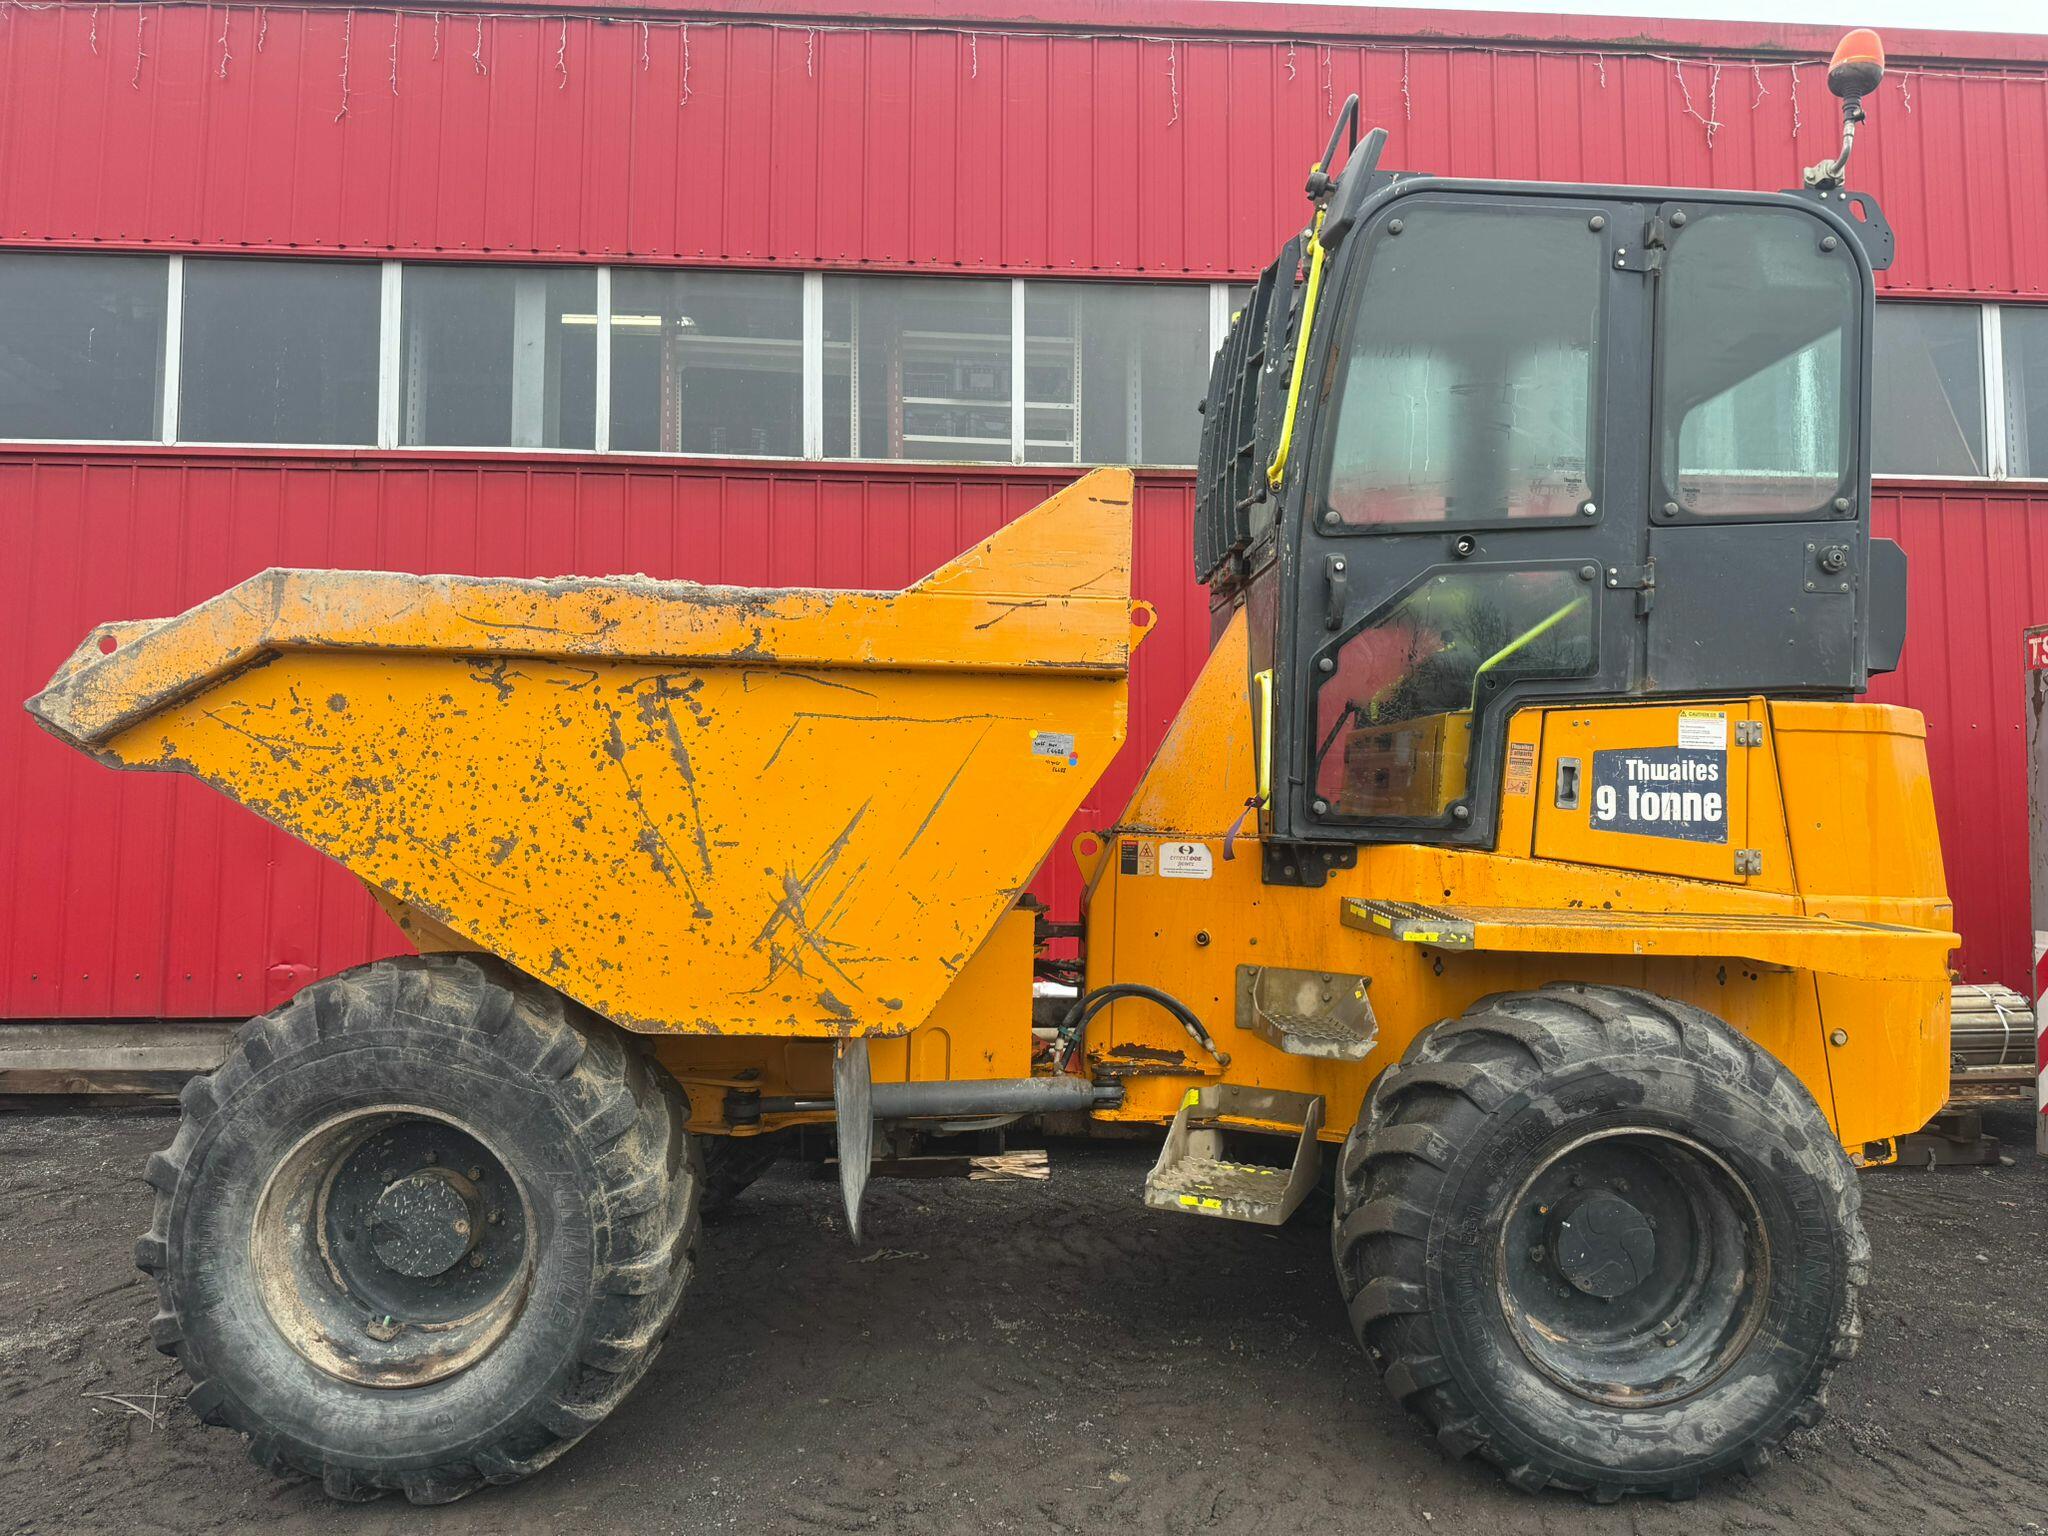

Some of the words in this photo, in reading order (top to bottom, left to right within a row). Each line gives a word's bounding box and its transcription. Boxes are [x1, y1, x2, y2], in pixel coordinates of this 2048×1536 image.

[1625, 759, 1719, 781] Thwaites
[1596, 784, 1617, 821] 9
[1628, 785, 1723, 822] tonne
